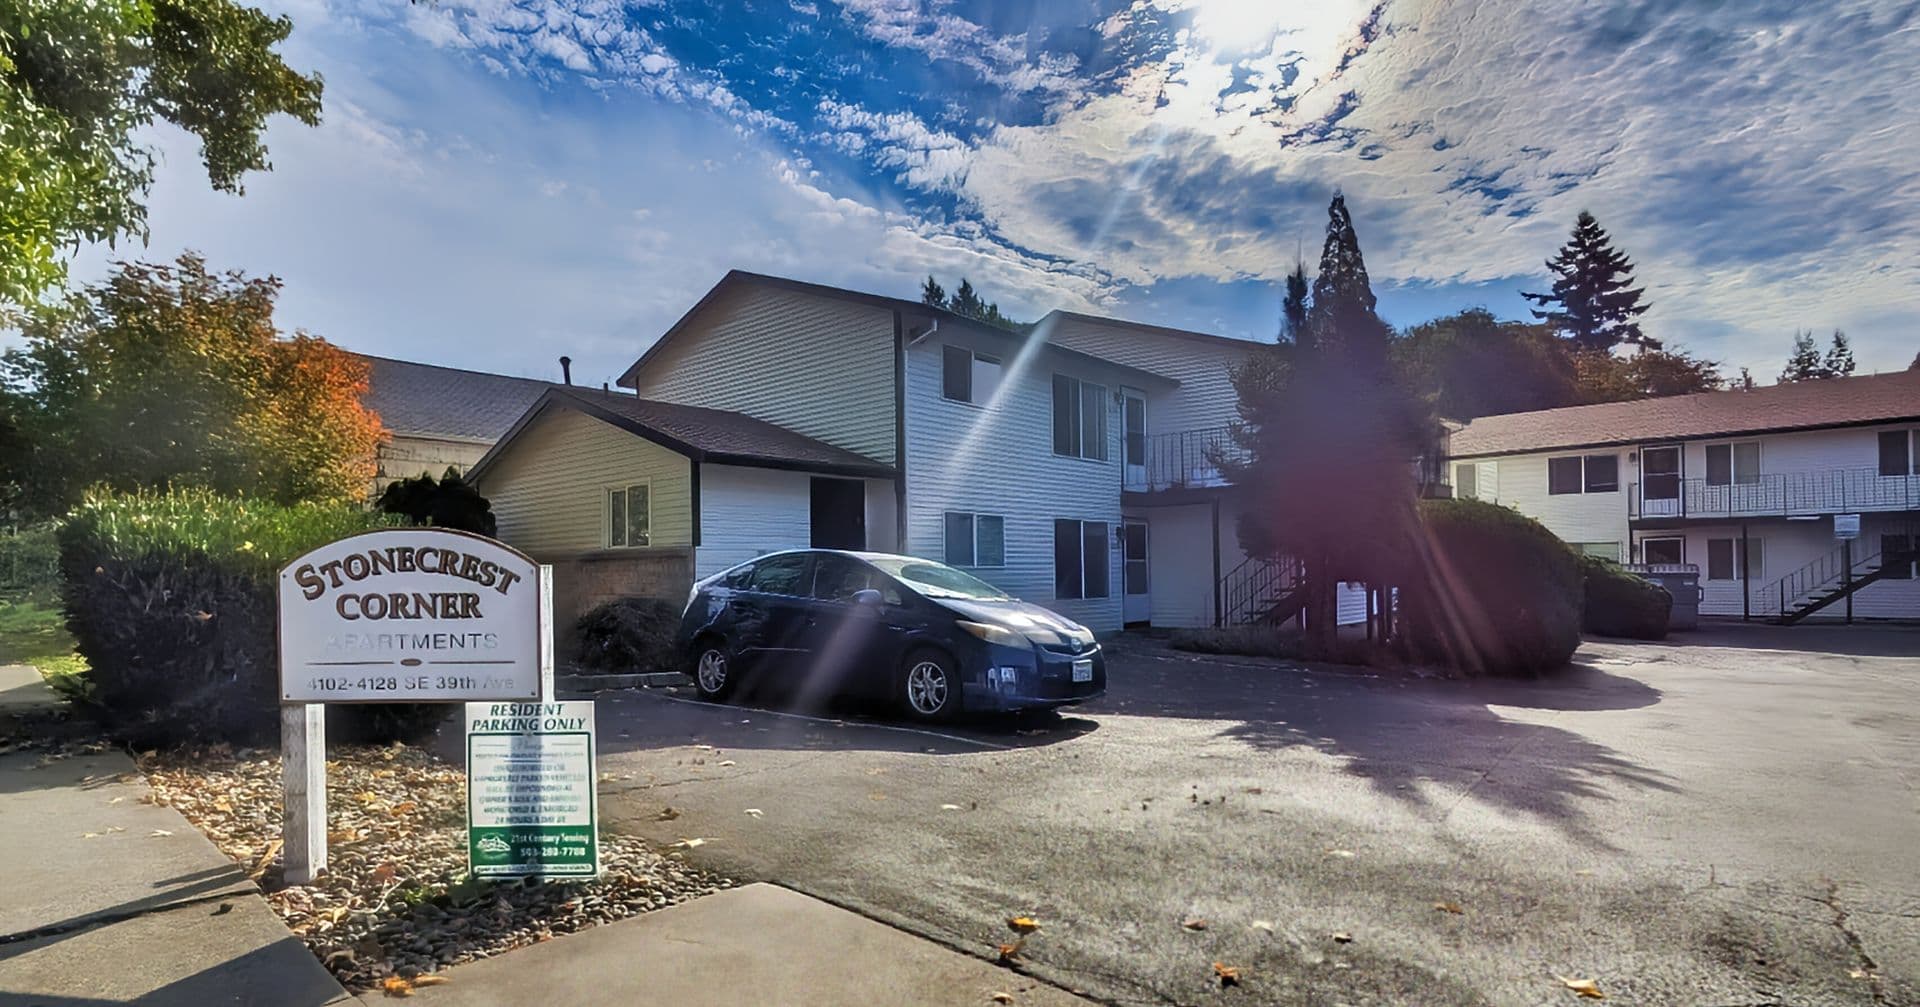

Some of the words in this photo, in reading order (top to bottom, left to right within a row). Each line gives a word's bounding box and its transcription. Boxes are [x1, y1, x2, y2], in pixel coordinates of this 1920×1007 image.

[294, 547, 521, 600] STONECREST
[336, 592, 483, 620] CORNER
[404, 676, 429, 690] SE
[436, 676, 476, 690] 39th
[490, 704, 566, 716] RESIDENT
[472, 719, 539, 731] PARKING
[544, 718, 586, 730] ONLY
